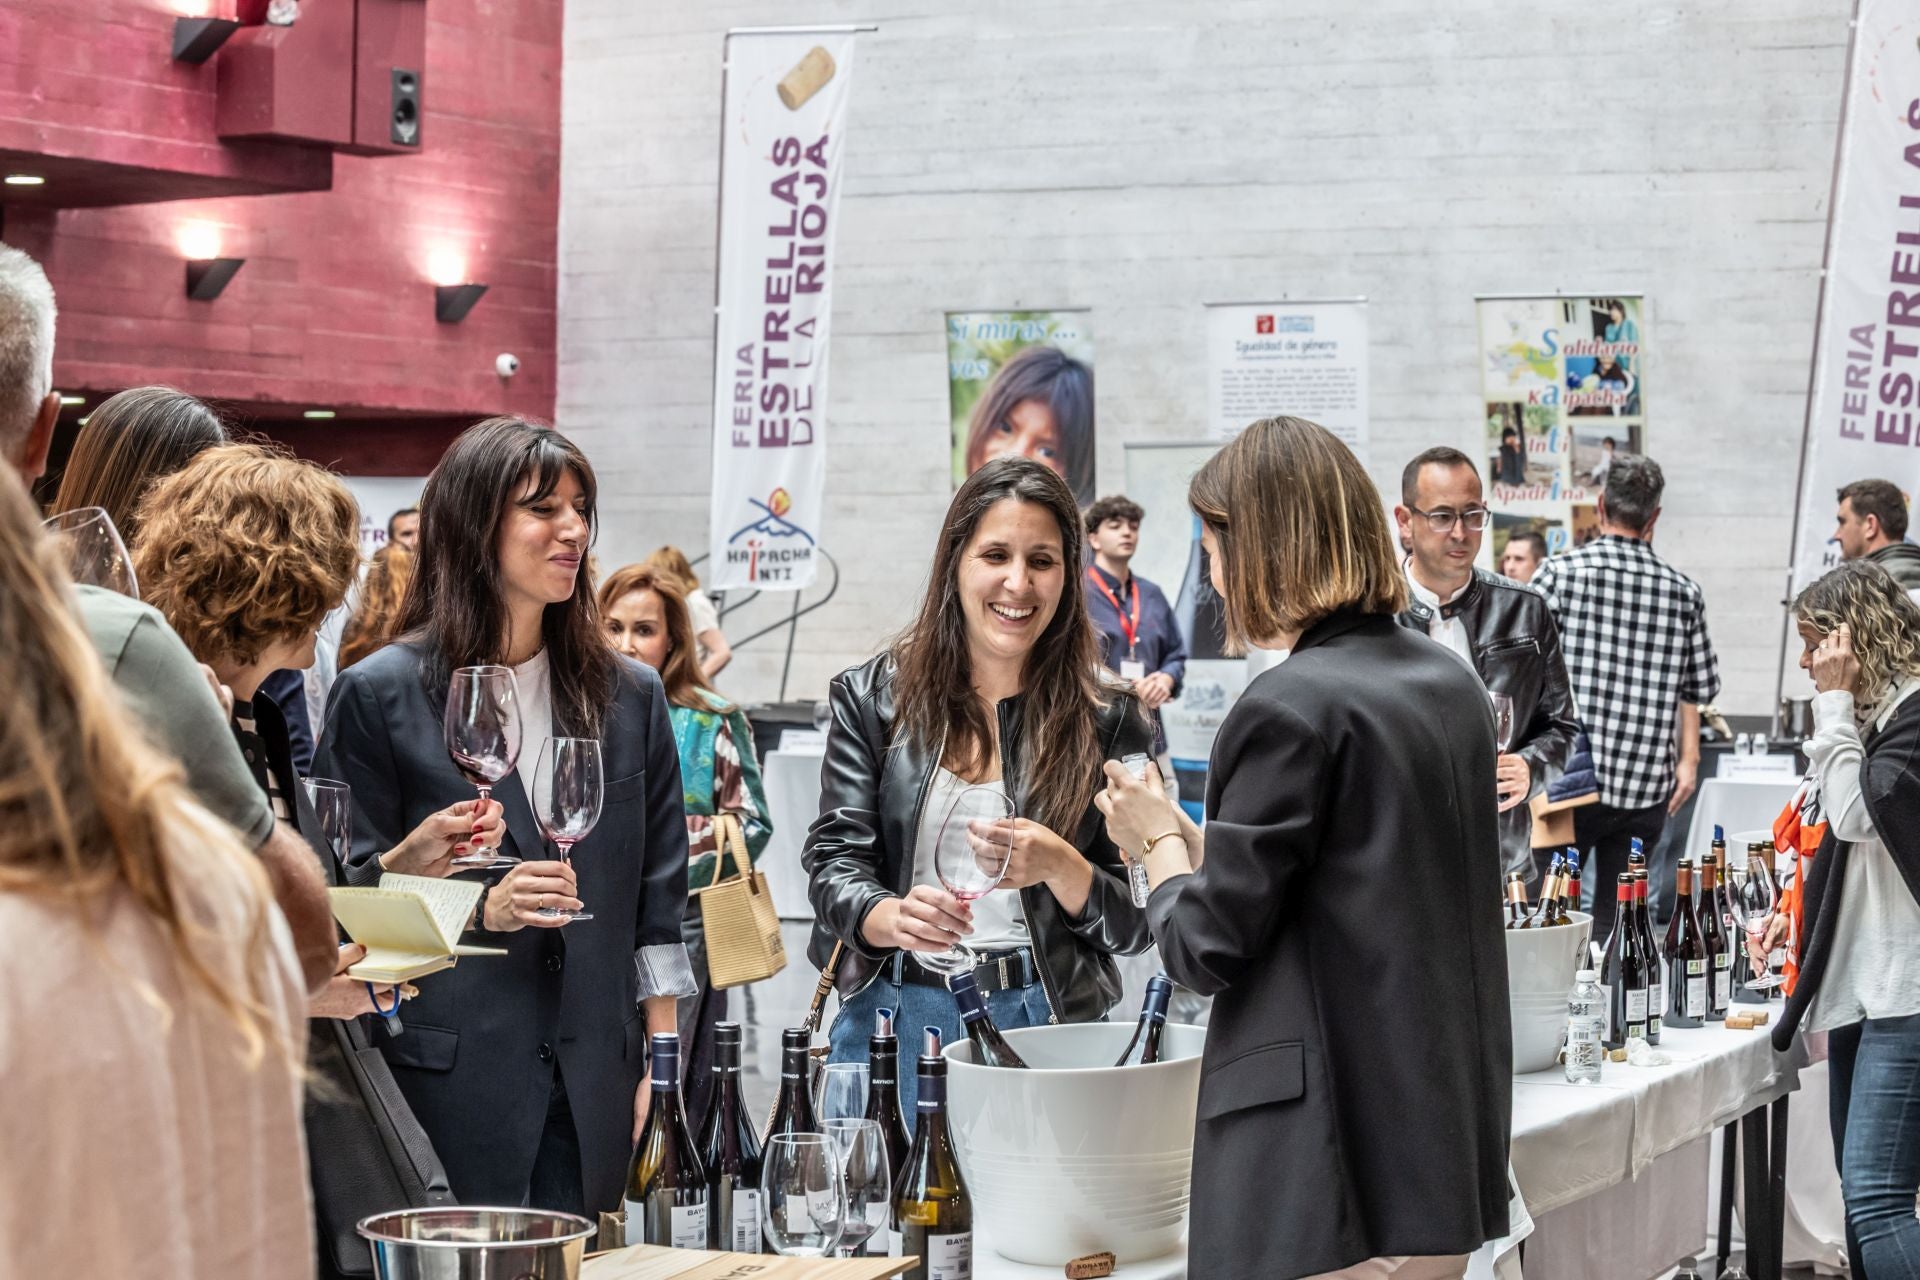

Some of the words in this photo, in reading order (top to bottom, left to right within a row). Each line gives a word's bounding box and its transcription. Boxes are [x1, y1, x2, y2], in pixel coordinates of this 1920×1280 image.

[795, 135, 829, 294] RIOJA
[758, 137, 801, 448] ESTRELLAS
[976, 315, 1048, 339] miras
[732, 342, 755, 448] FERIA
[791, 384, 814, 446] DE
[1840, 323, 1877, 441] FERIA
